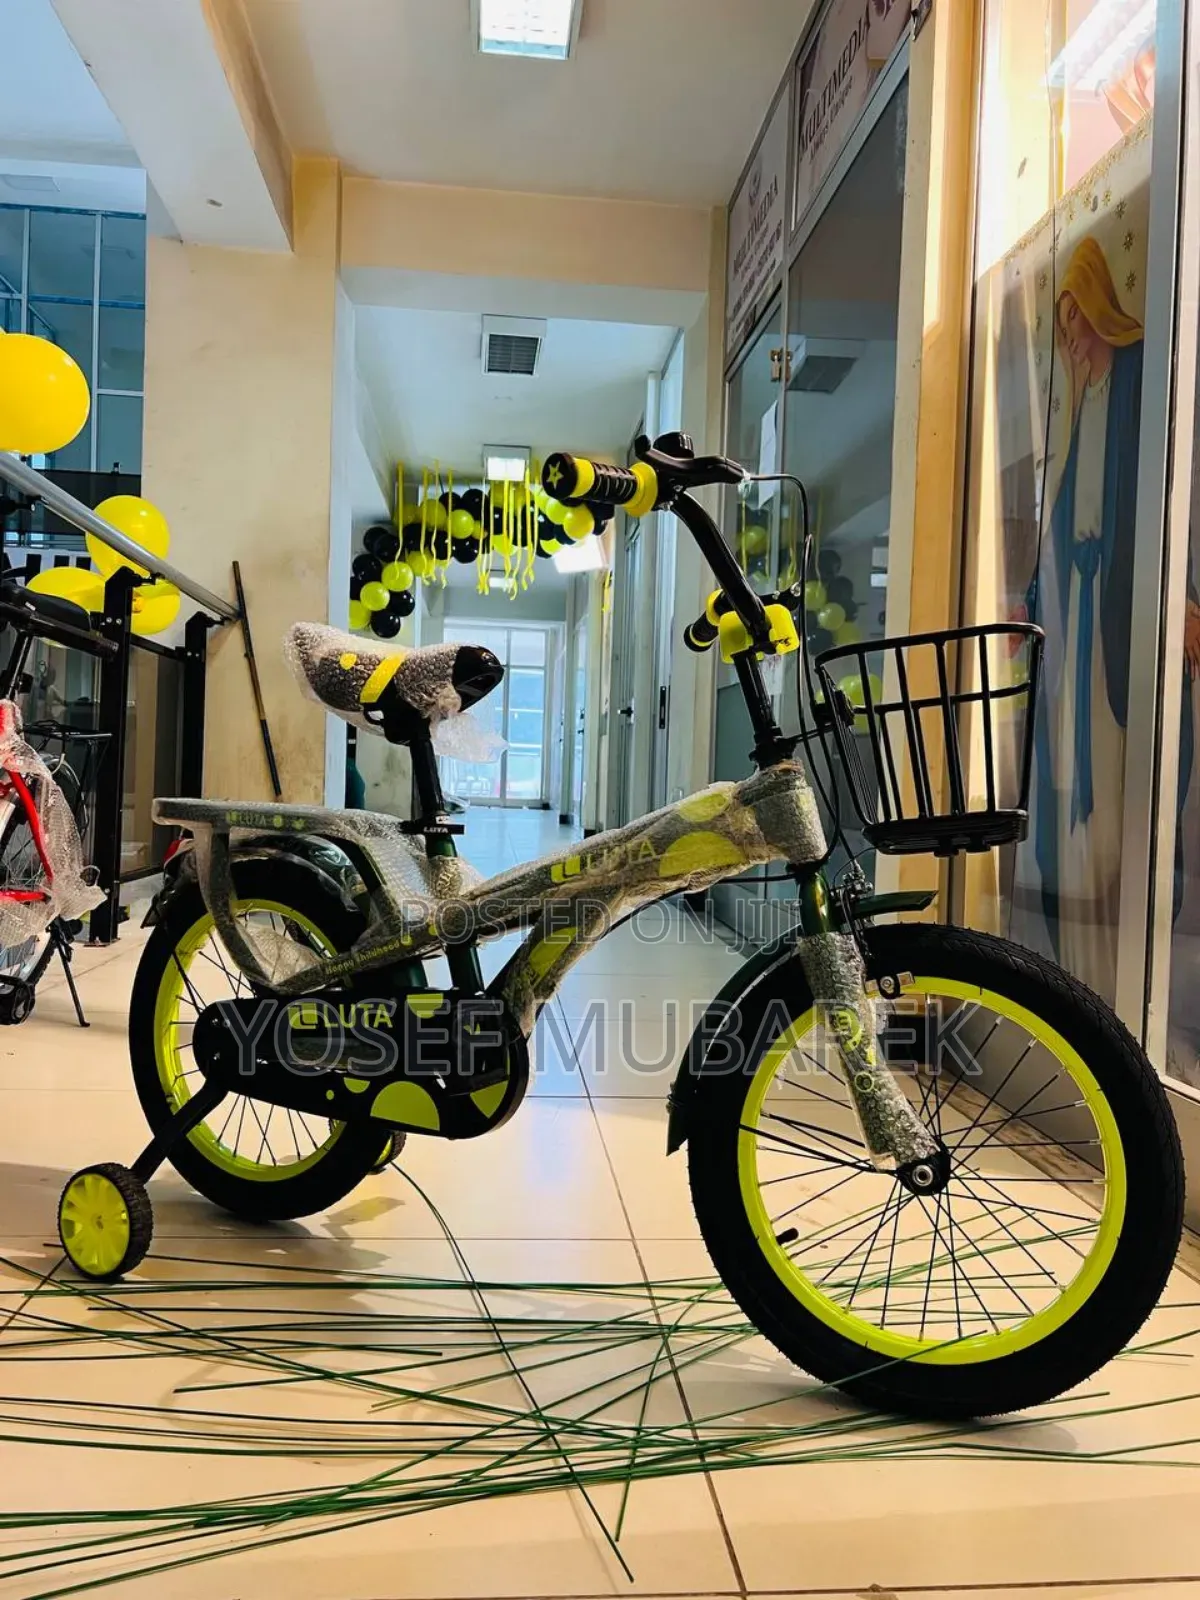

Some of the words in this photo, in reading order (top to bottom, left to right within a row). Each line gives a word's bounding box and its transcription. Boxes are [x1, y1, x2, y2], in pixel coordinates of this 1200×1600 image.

[799, 14, 870, 162] MULTIMEDIA
[240, 811, 268, 828] LUTA
[423, 826, 449, 834] LUTA
[322, 1003, 394, 1029] LUTA
